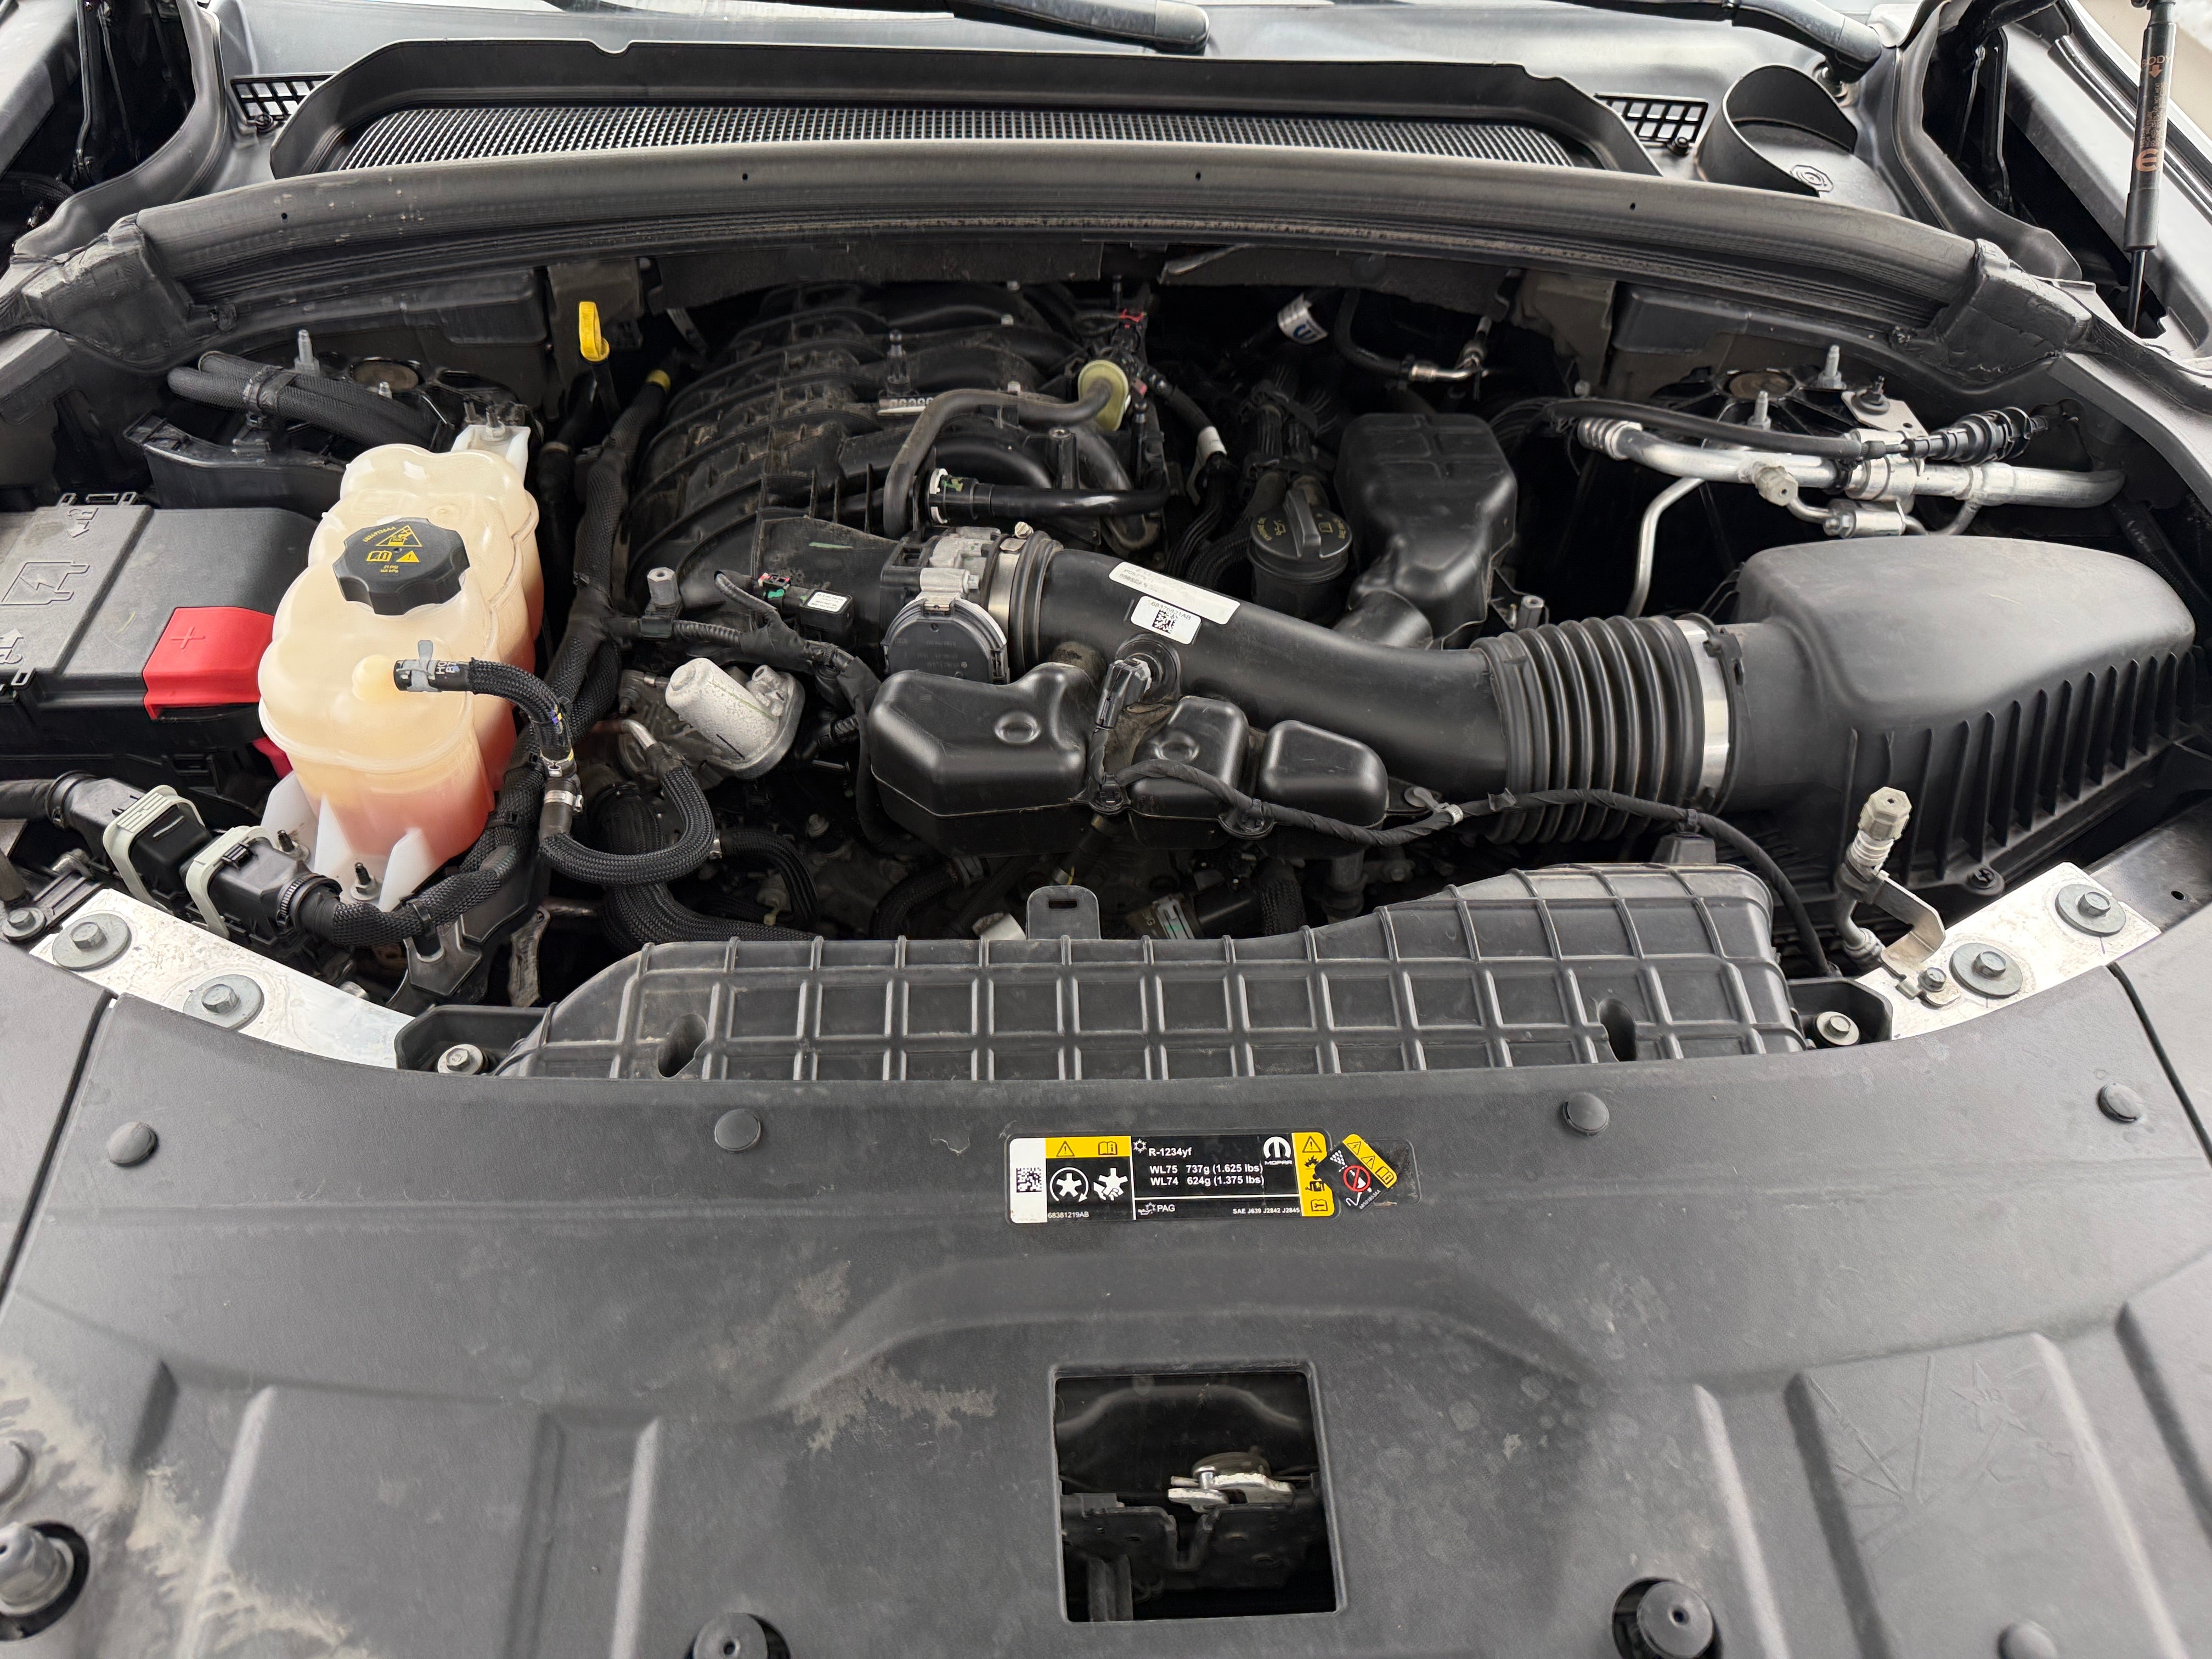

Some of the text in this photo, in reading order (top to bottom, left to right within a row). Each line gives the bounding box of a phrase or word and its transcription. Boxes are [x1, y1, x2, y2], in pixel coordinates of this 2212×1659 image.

[2141, 55, 2171, 67] BODY
[1148, 1147, 1193, 1158] R-1234yf
[1149, 1163, 1263, 1175] WL75 737g (1.625 lbs)
[1150, 1175, 1265, 1187] WL74 624g (1.375 lbs)
